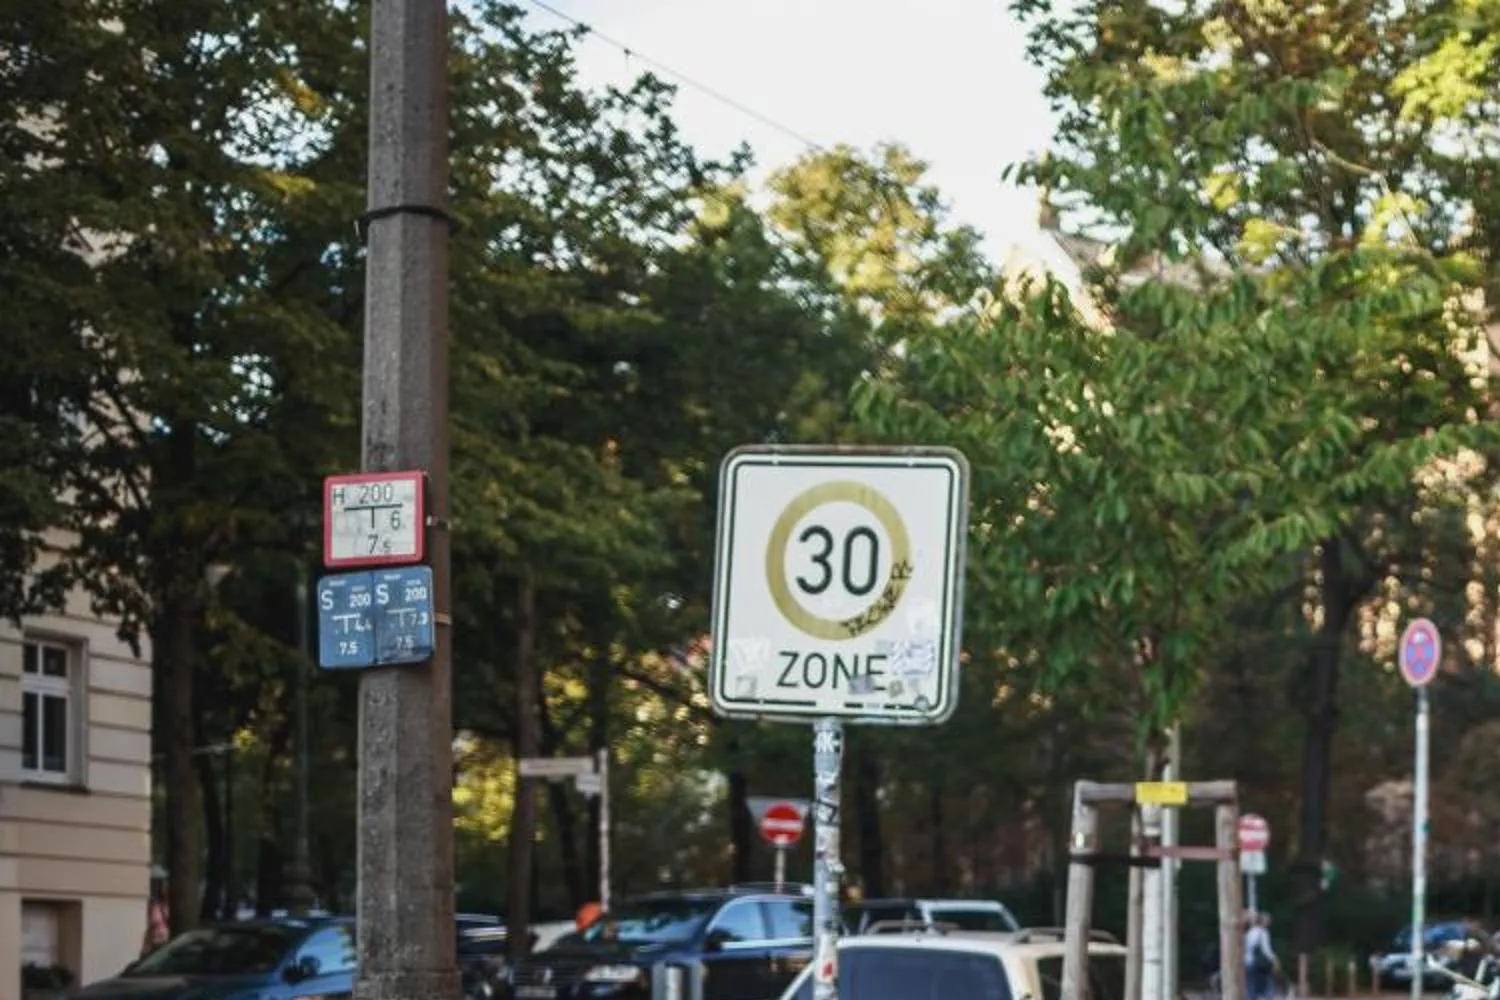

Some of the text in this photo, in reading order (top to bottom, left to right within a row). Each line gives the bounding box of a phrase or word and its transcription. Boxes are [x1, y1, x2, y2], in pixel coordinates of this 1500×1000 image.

[333, 483, 393, 505] H 200
[391, 510, 401, 530] 6
[796, 524, 880, 597] 30
[321, 589, 372, 610] S 200
[376, 583, 428, 605] S 200
[776, 650, 888, 692] ZONE
